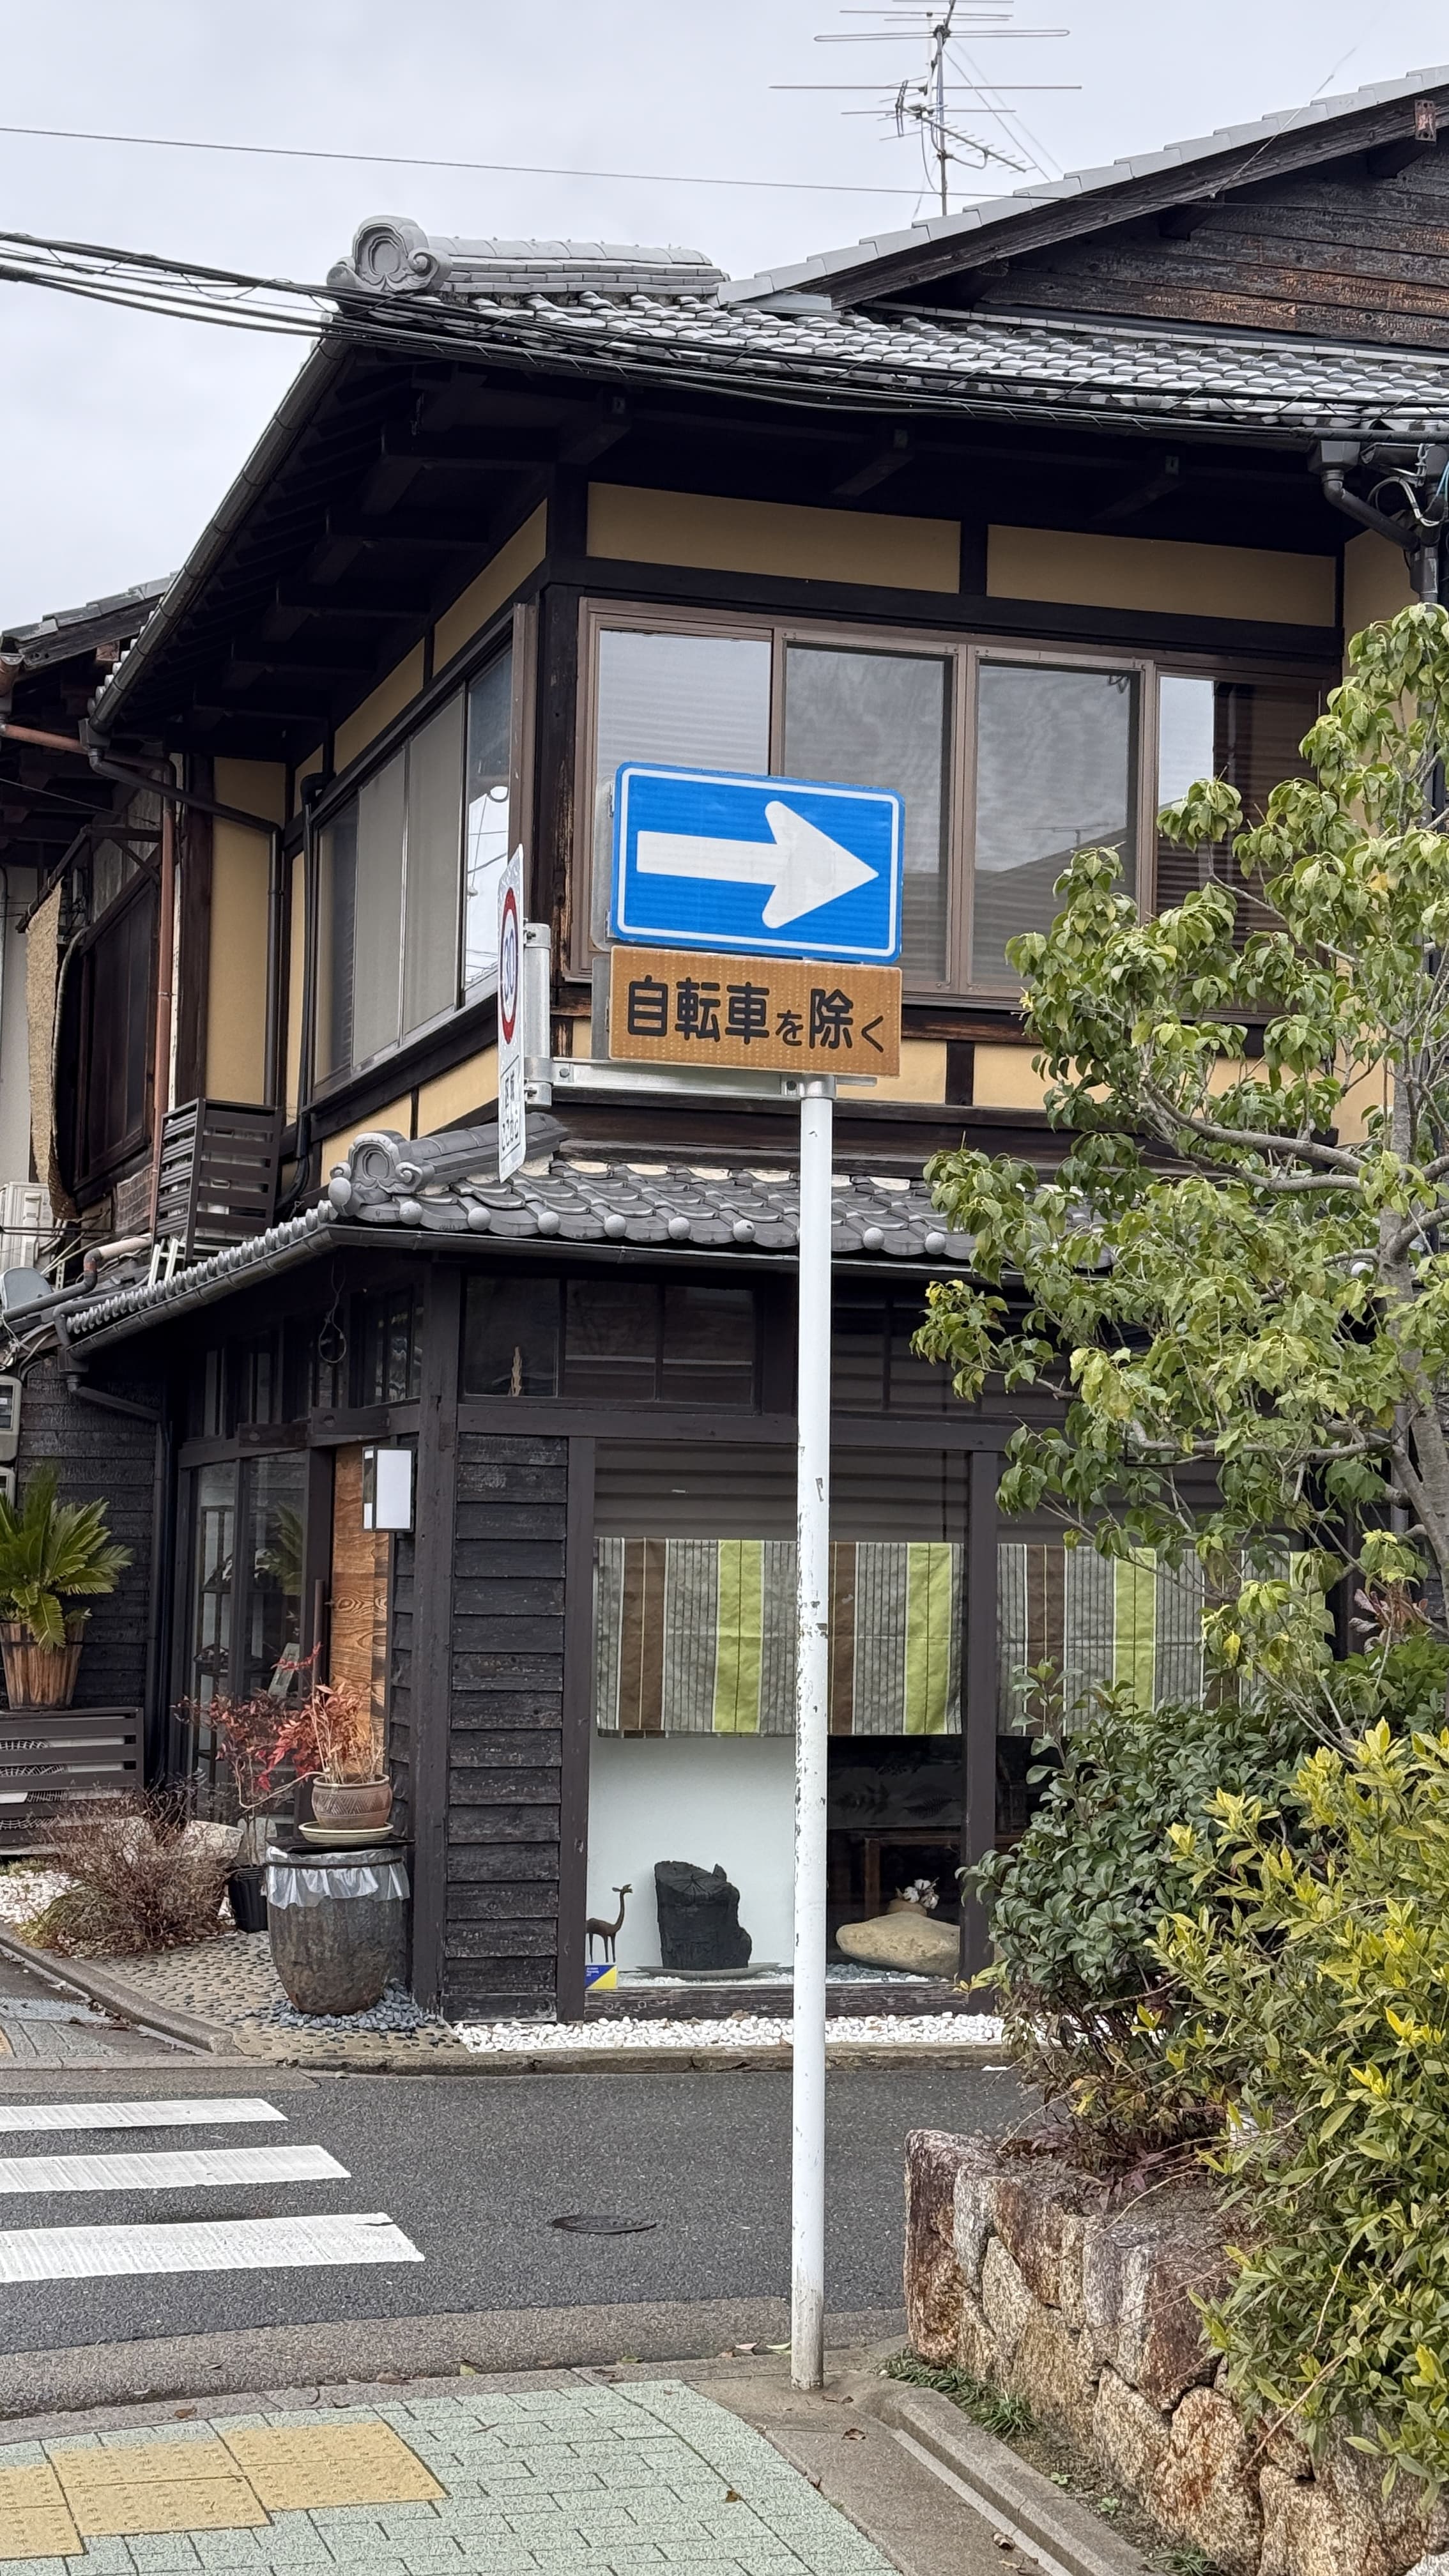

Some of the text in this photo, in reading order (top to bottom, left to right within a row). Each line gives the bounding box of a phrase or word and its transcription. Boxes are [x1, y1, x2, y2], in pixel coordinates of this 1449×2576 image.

[627, 975, 884, 1053] 自転車を除く
